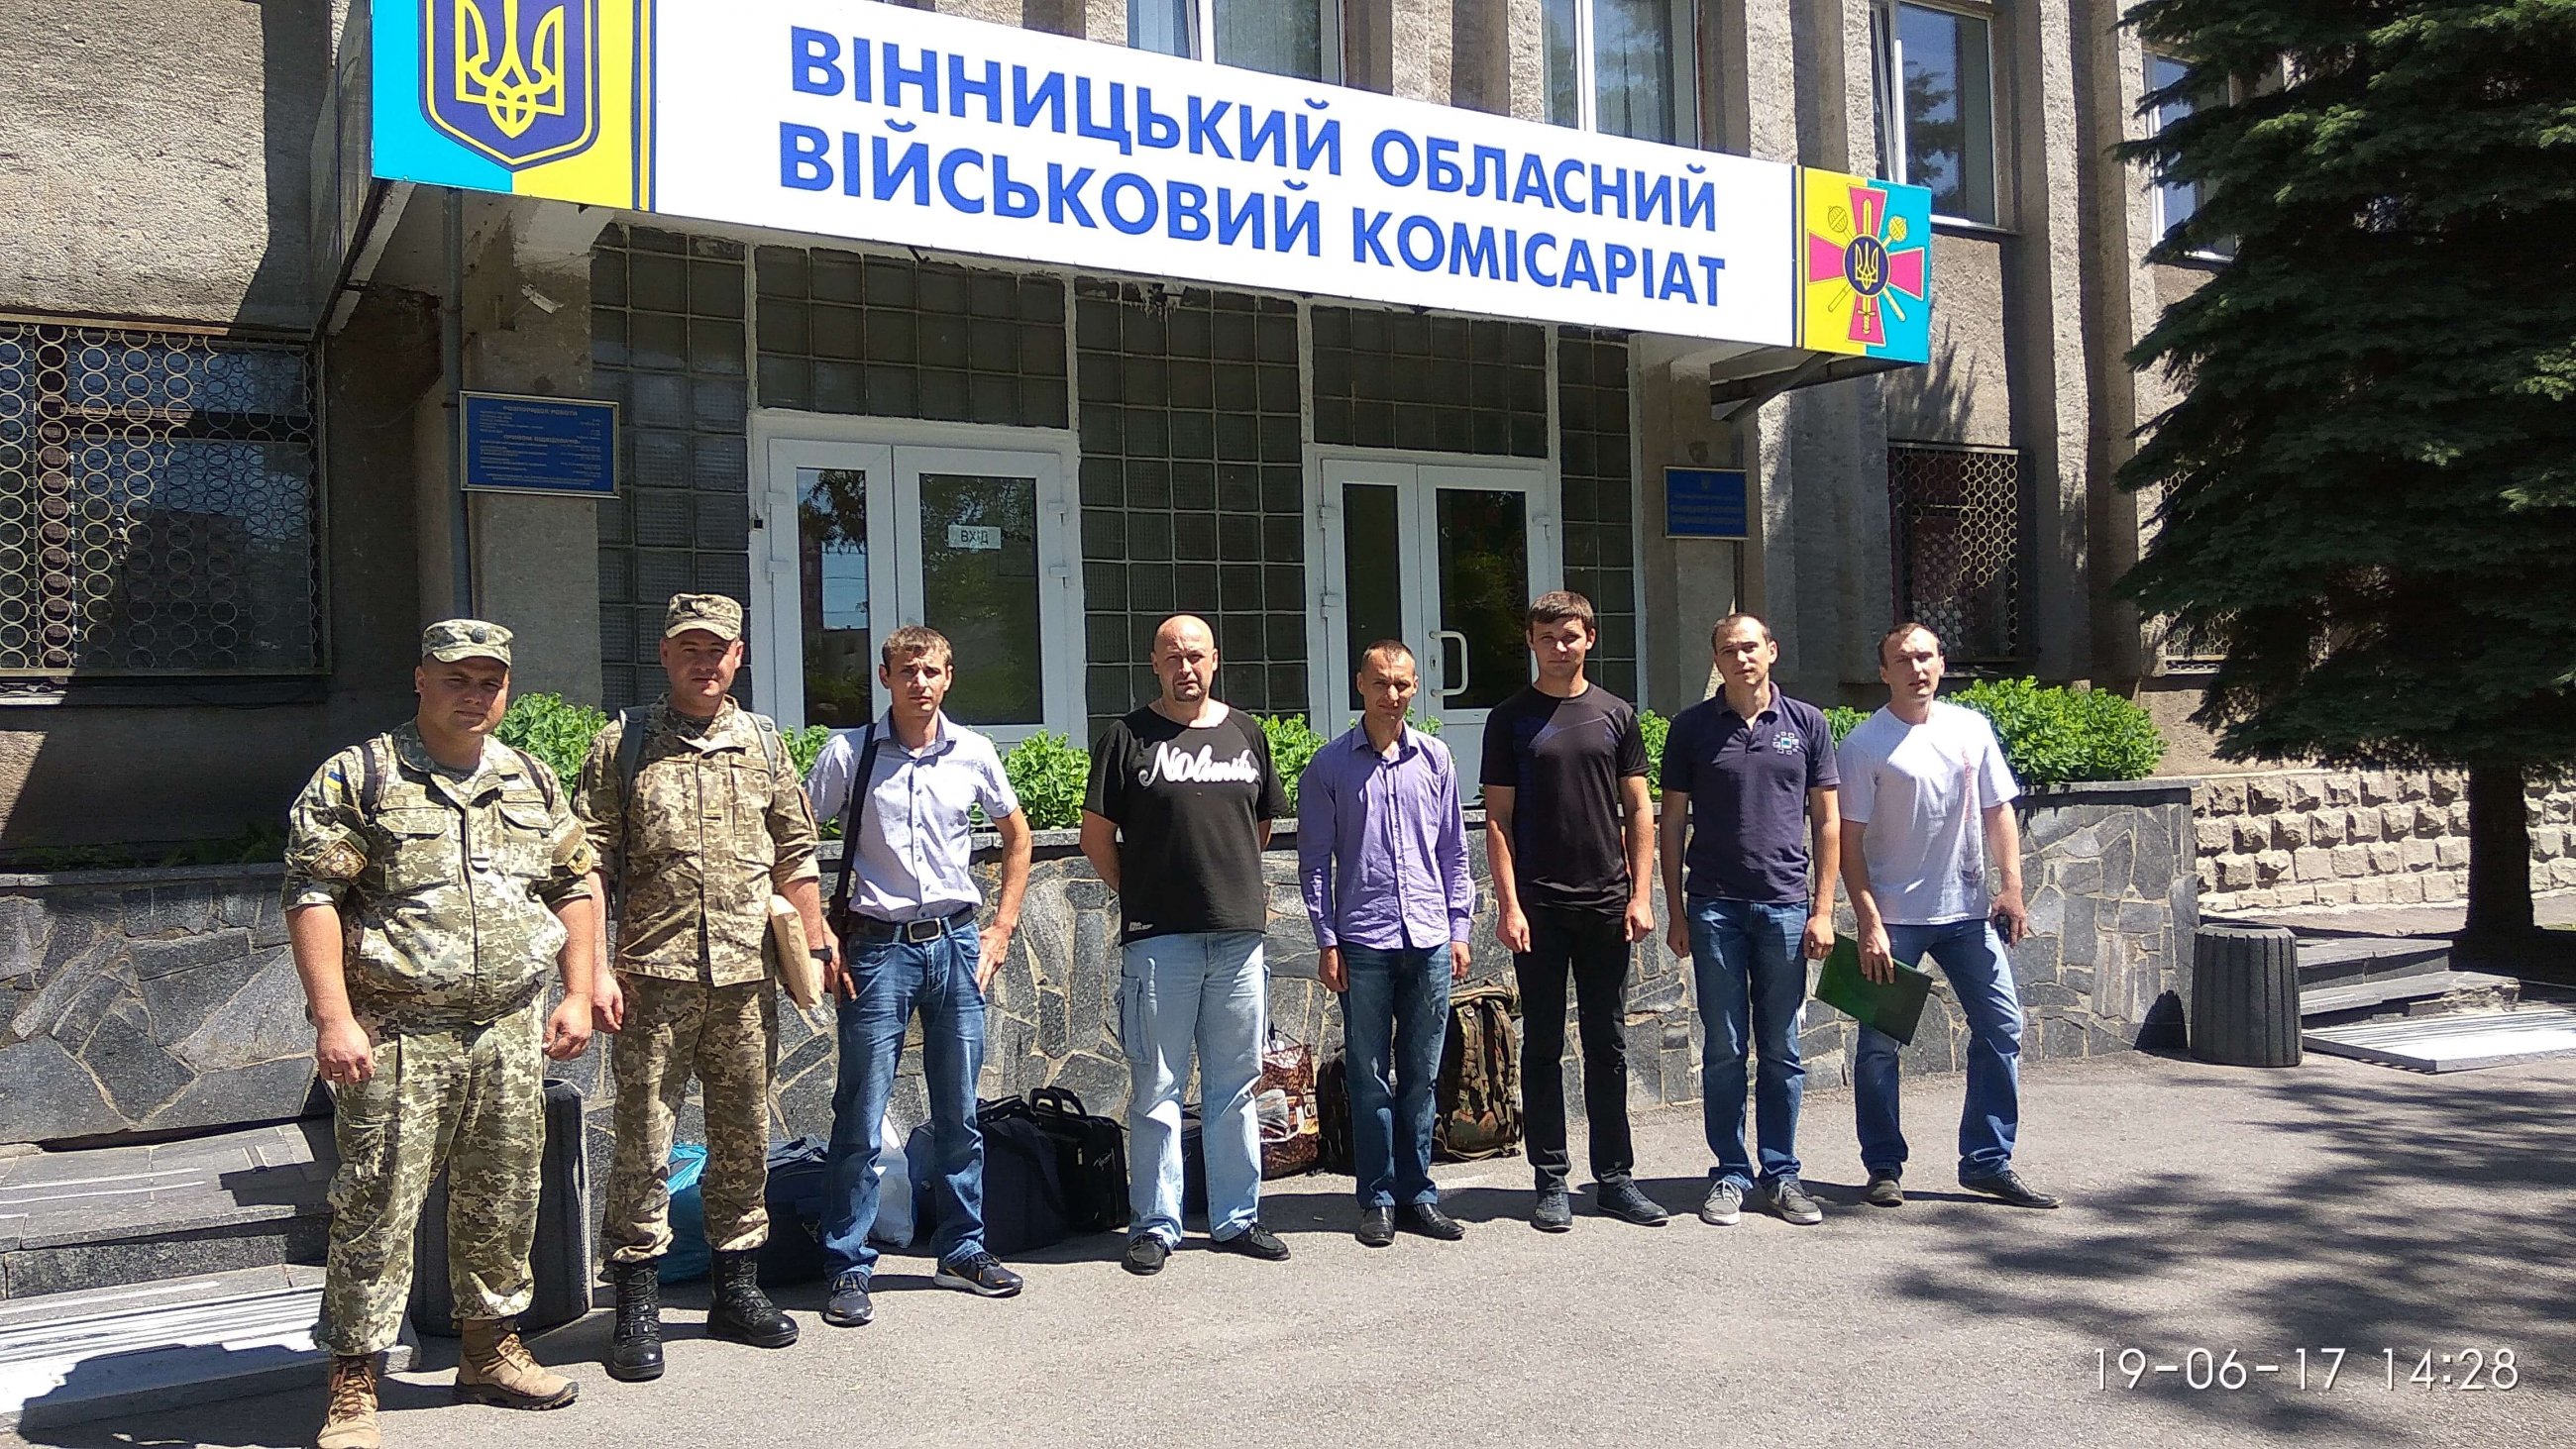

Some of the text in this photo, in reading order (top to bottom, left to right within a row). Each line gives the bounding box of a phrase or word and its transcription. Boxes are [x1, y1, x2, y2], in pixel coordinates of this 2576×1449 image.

[780, 122, 1725, 307] ВІЙСЬКОВИЙ КОМІСАРІАТ
[791, 26, 1716, 232] ВІННИЦЬКИЙ ОБЛАСНИЙ
[960, 529, 989, 546] ВХІД
